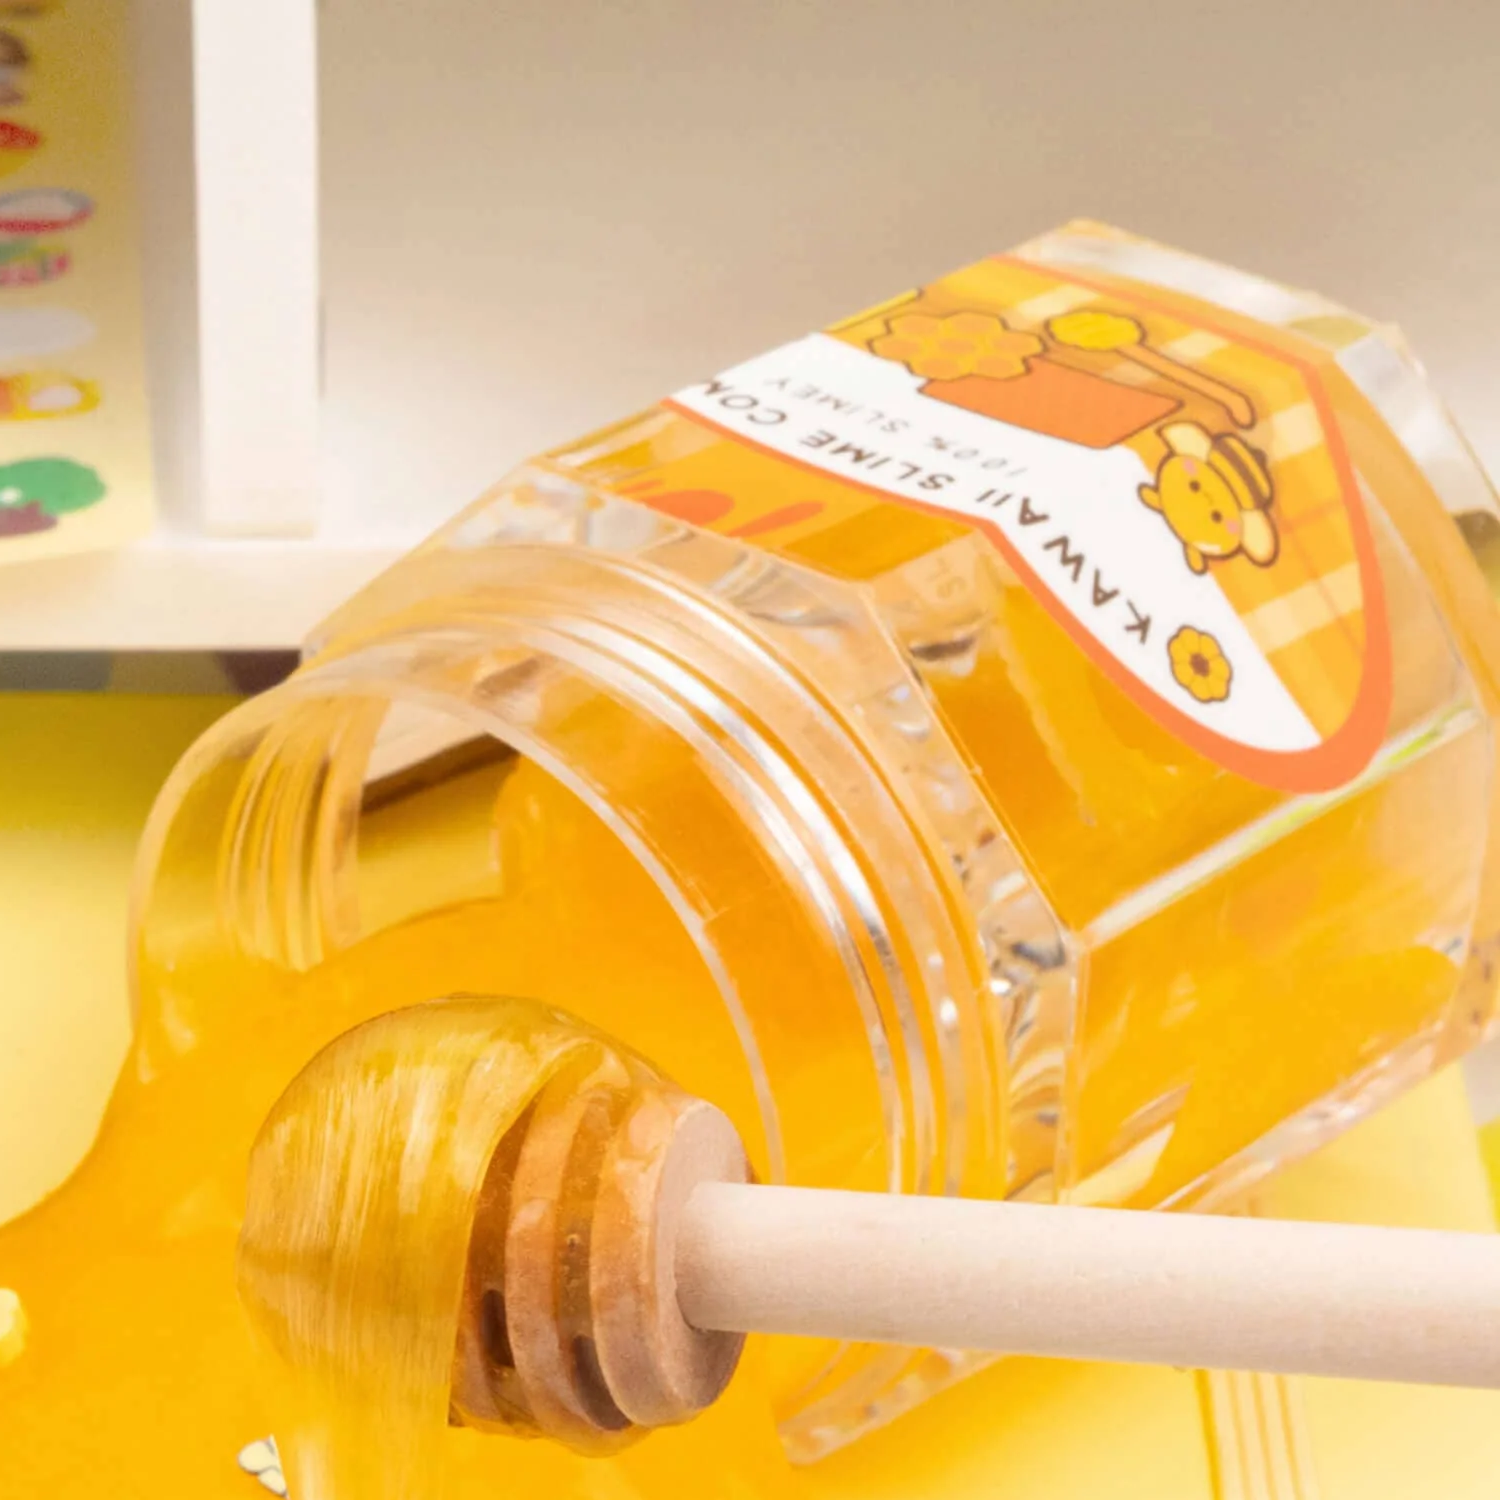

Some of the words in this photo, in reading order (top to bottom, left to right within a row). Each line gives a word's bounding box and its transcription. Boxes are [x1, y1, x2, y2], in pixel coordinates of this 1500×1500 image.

[763, 376, 911, 435] SLIMEY
[799, 429, 956, 491] SLIME
[923, 436, 1028, 478] 100%
[975, 487, 1151, 645] KAWAII
